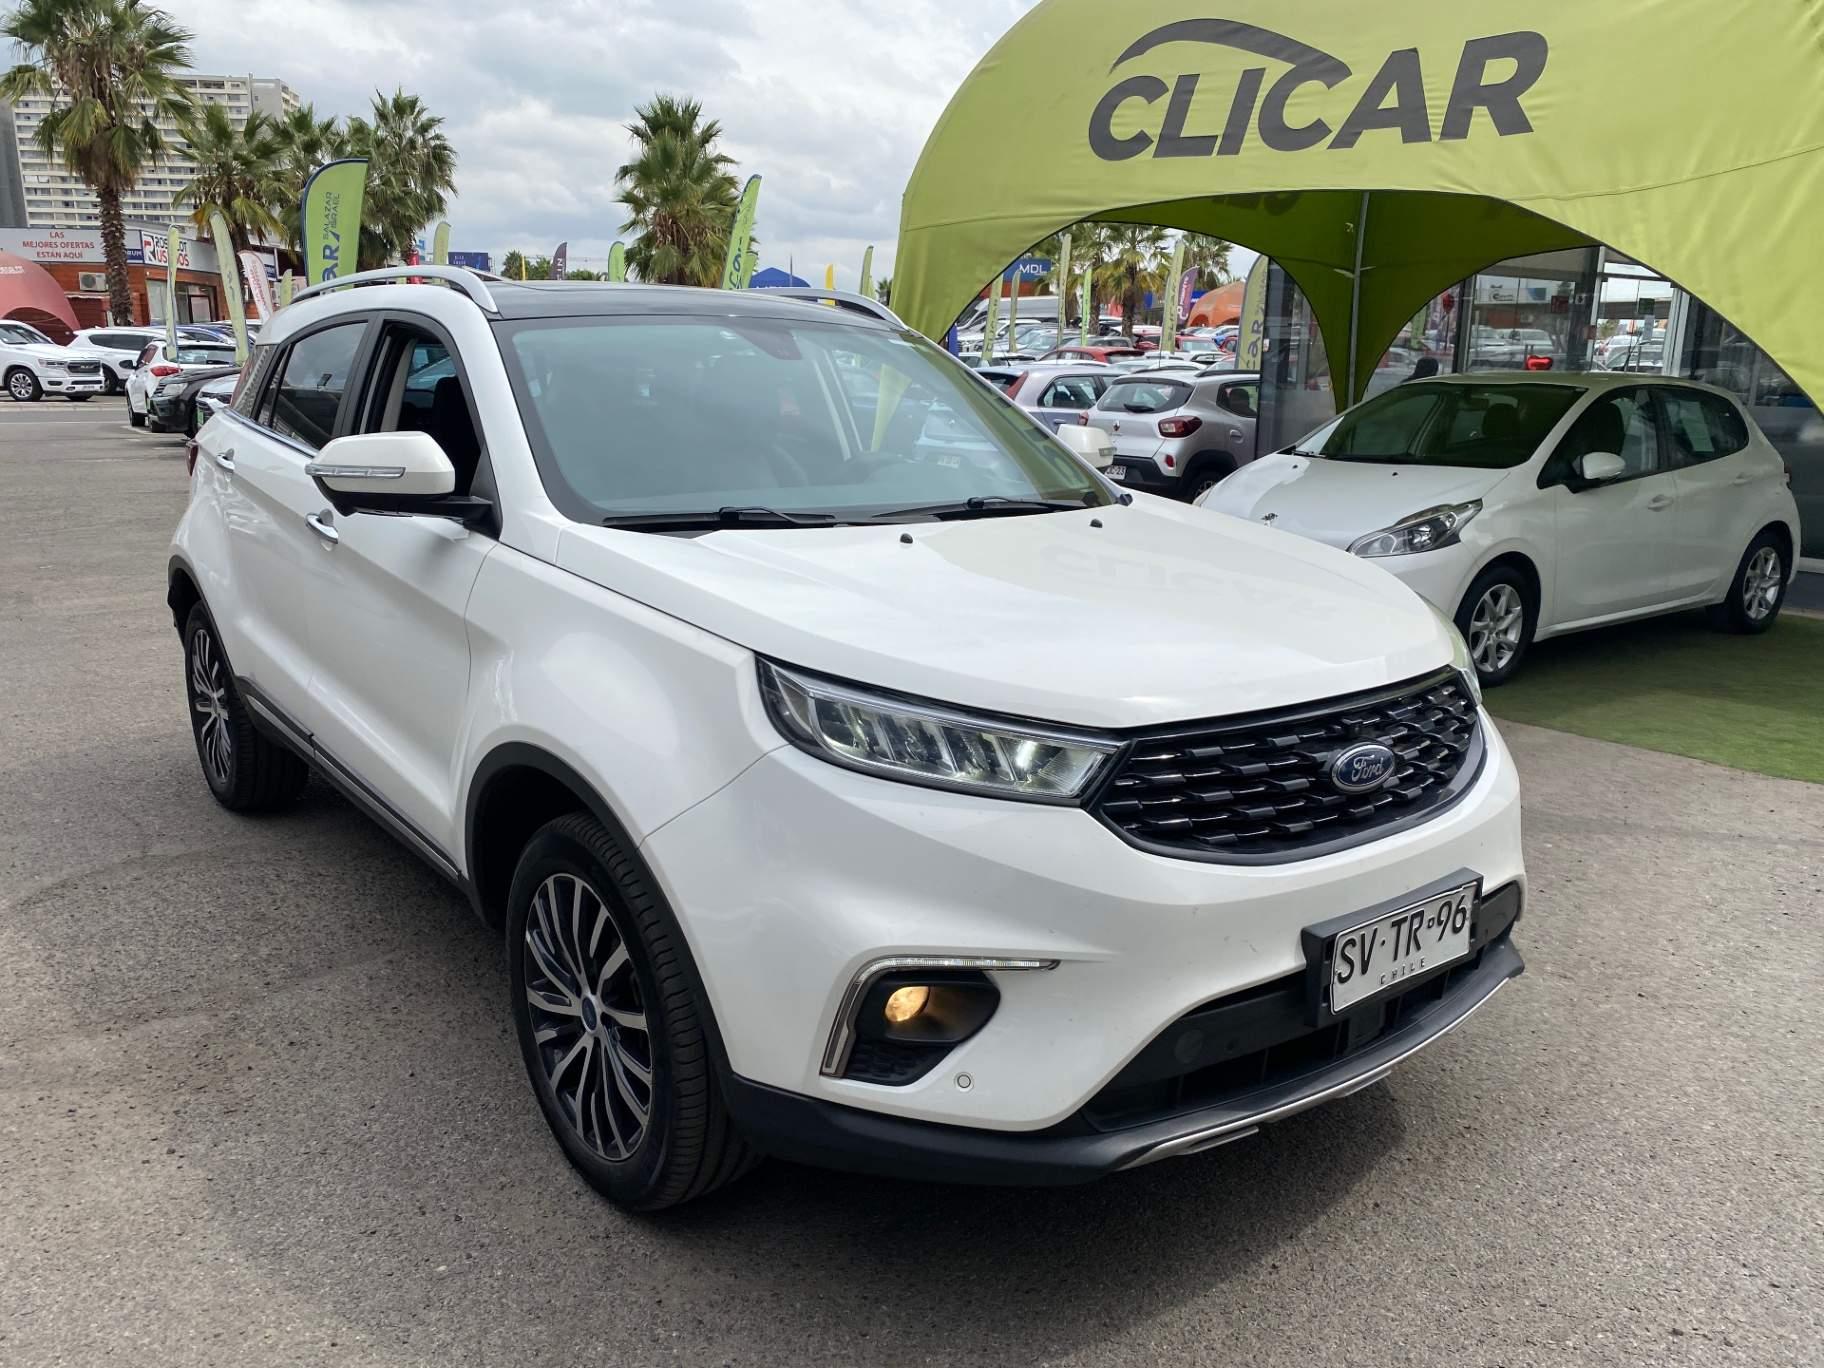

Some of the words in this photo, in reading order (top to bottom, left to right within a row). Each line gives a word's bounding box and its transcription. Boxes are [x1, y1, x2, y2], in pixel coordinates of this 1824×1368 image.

[1088, 28, 1549, 162] CLICAR
[22, 240, 59, 249] MEJORES
[60, 241, 95, 249] OFERTAS
[49, 231, 65, 239] LAS
[1019, 263, 1048, 274] MDL
[1350, 754, 1384, 783] Ford
[1379, 958, 1426, 986] CHILE
